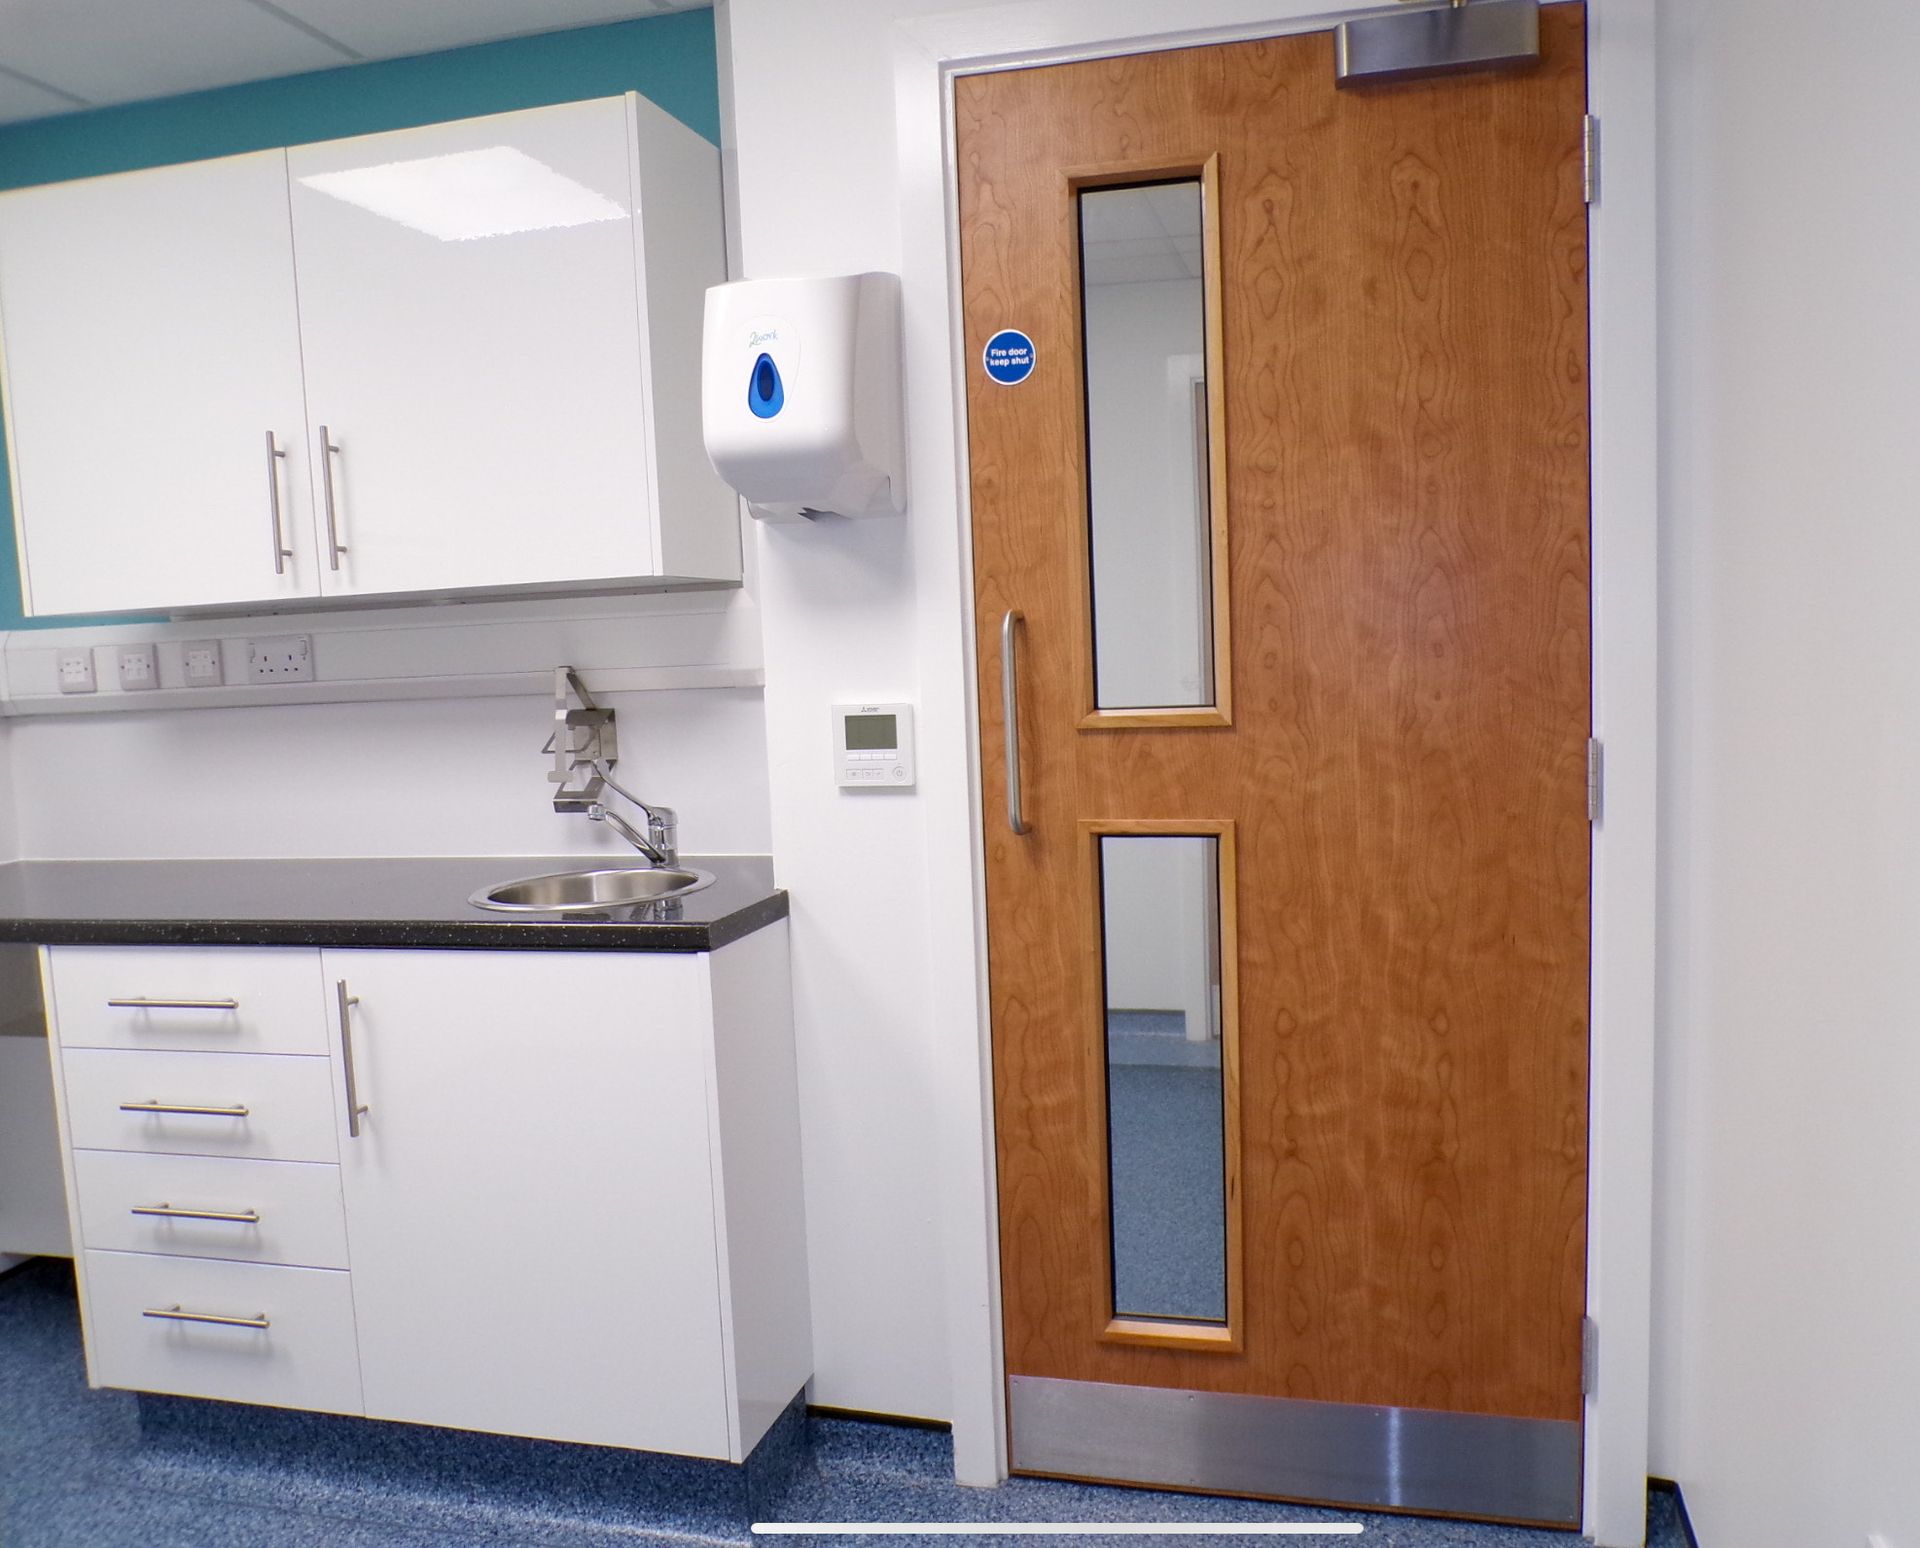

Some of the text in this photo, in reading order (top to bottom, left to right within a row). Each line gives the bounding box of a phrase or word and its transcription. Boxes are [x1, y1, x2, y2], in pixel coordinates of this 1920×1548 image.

[991, 348, 1028, 357] Fire door
[990, 356, 1030, 367] keep shut
